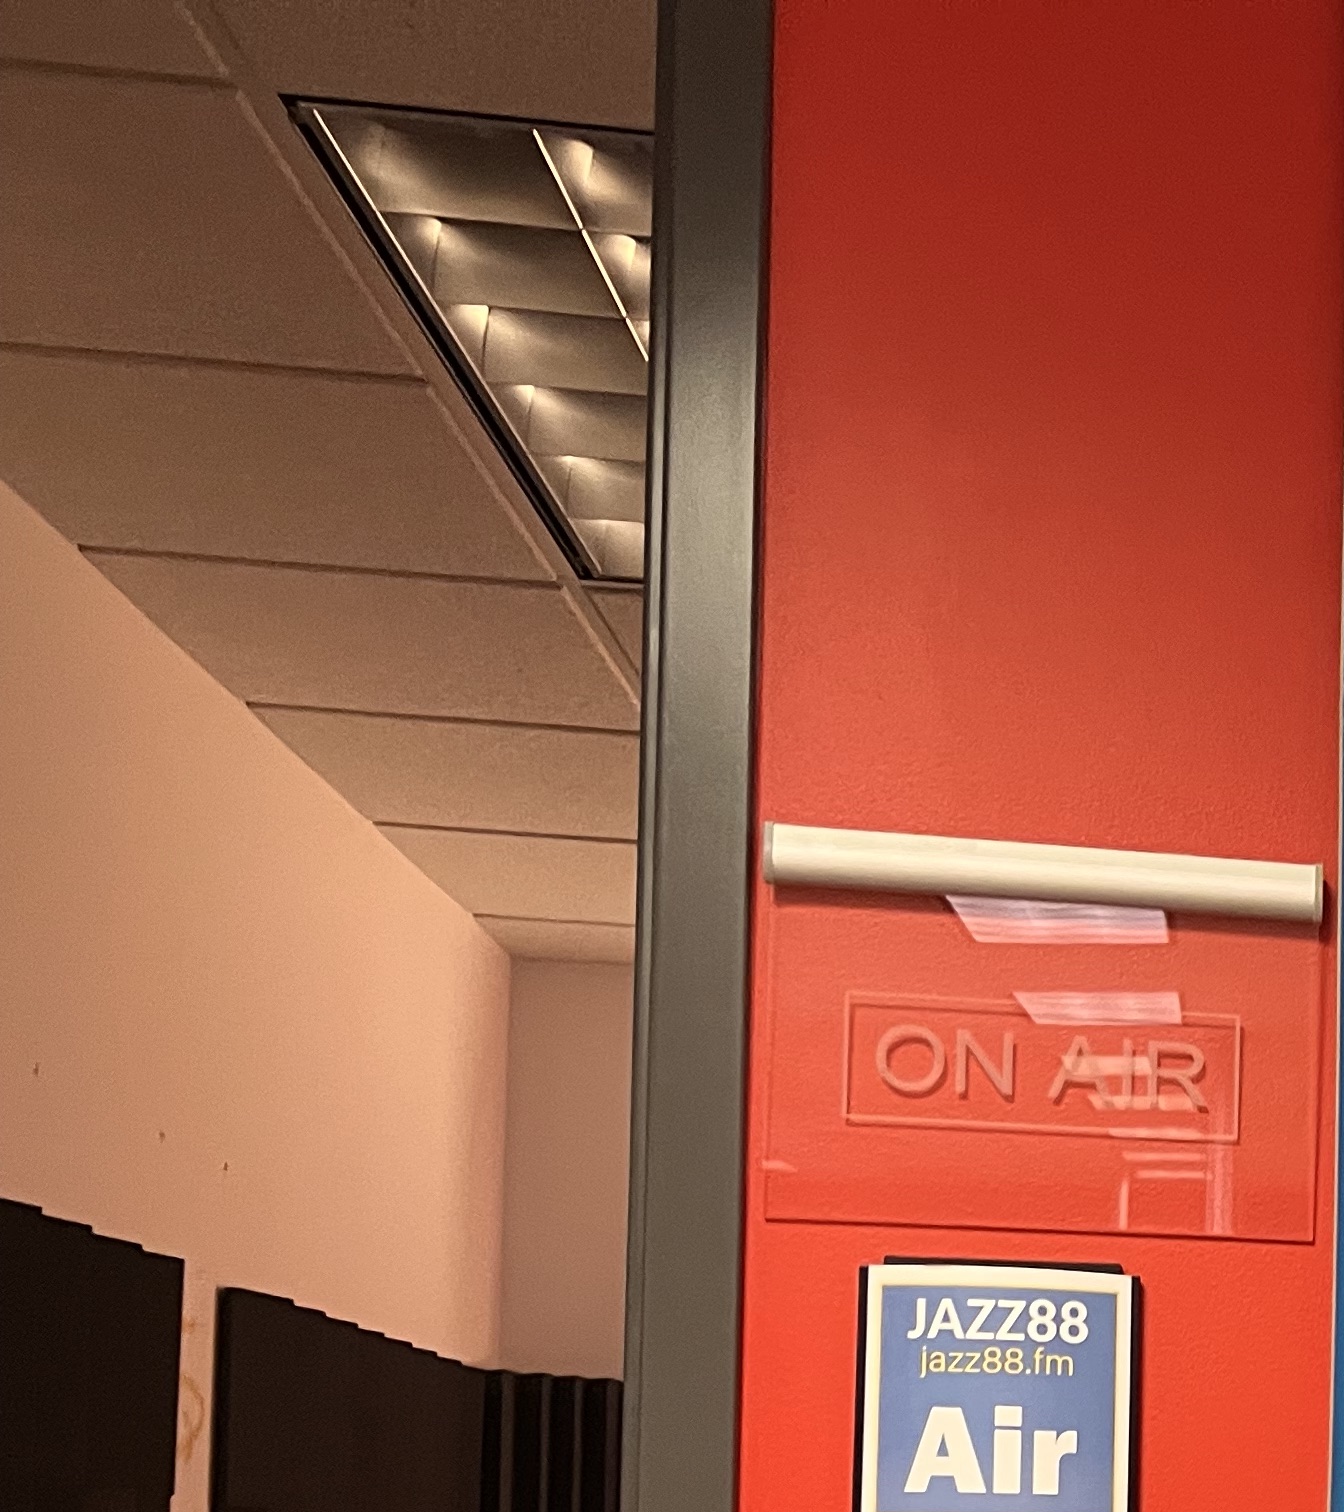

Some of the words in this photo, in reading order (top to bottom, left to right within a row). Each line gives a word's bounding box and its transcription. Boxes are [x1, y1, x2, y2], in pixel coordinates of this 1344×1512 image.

[875, 1023, 1016, 1100] ON
[1048, 1034, 1208, 1114] AIR
[906, 1297, 1090, 1344] JAZZ88
[919, 1346, 1075, 1378] jazz88.fm
[904, 1405, 1078, 1497] Air
